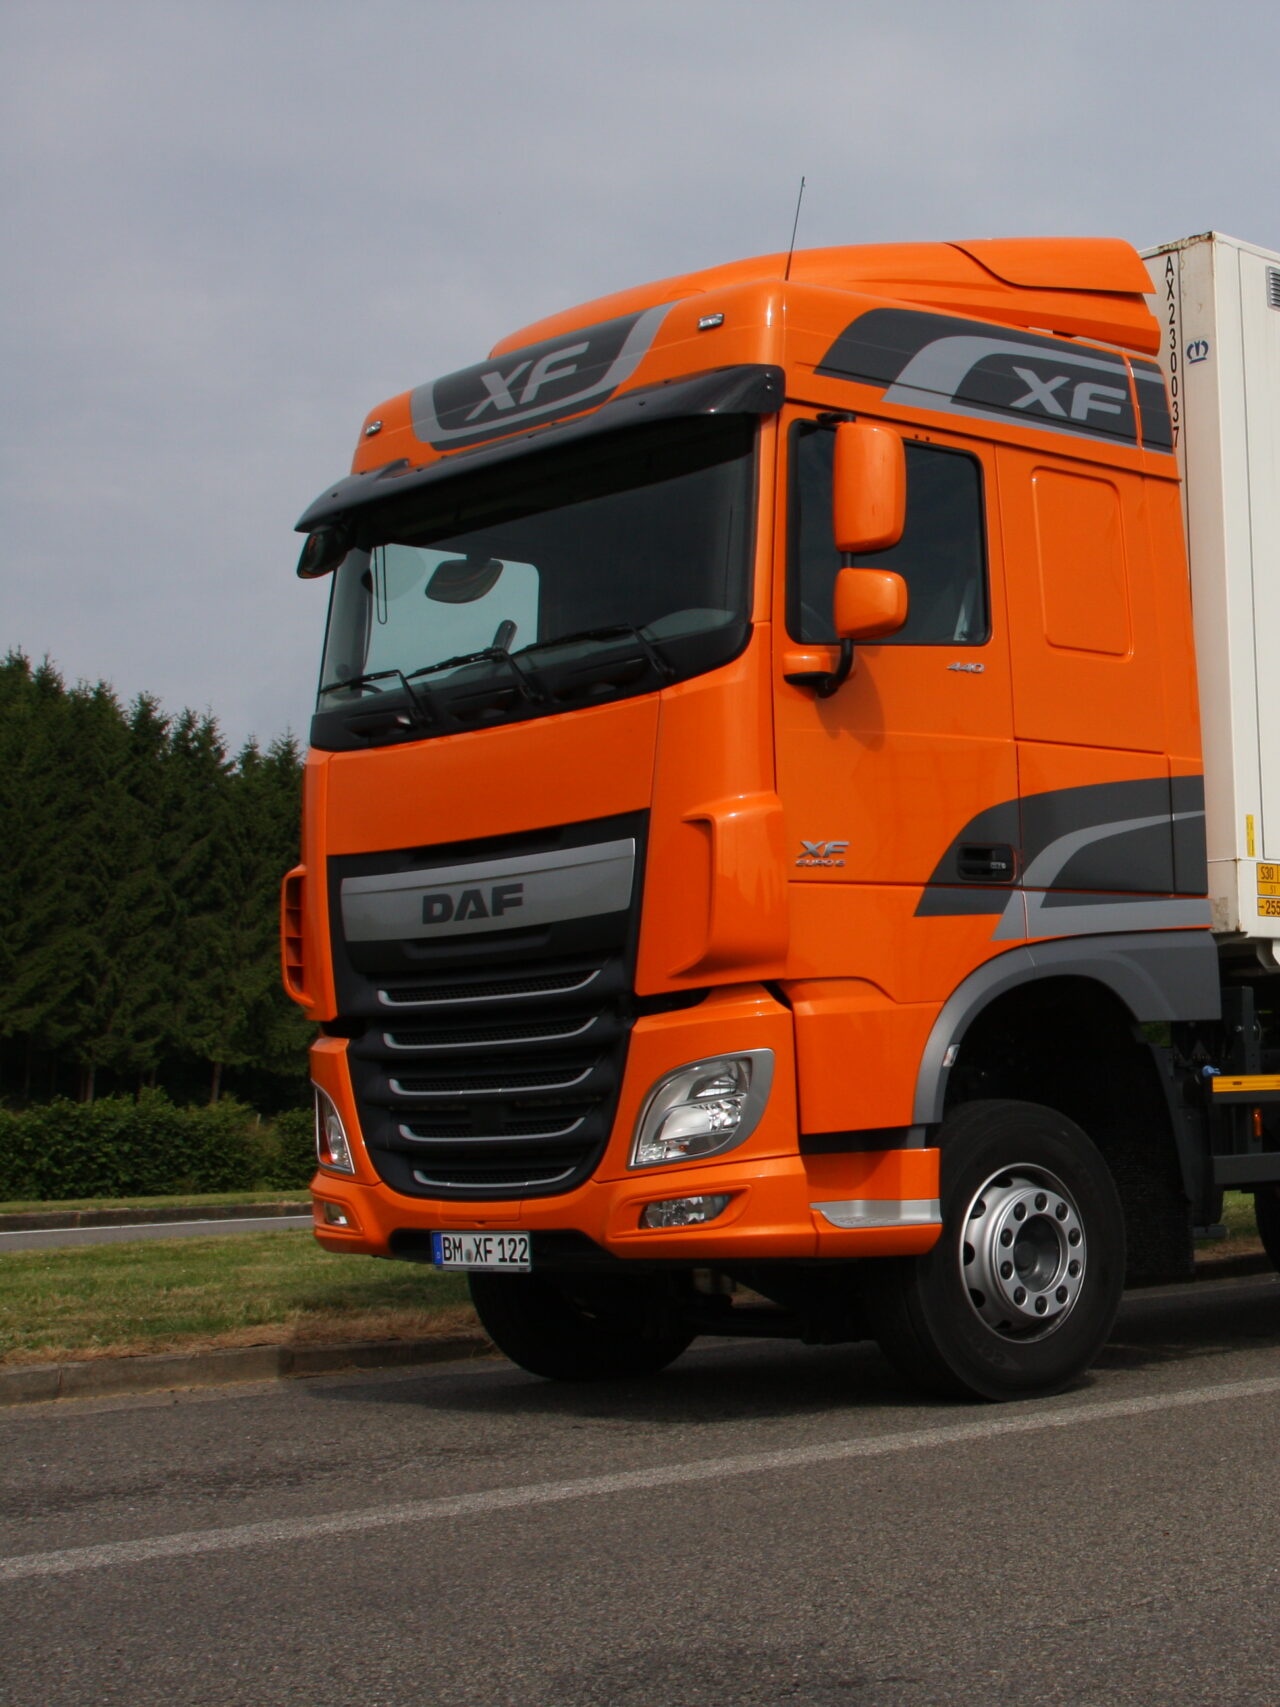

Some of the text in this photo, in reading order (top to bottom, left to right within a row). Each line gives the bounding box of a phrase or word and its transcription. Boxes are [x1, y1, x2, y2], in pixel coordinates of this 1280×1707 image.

[1165, 256, 1179, 448] AX230037
[464, 341, 590, 421] XF
[1009, 366, 1127, 421] XF
[797, 841, 849, 857] XF
[1261, 866, 1274, 880] S30
[422, 883, 523, 924] DAF
[443, 1237, 529, 1263] BM XF 122
